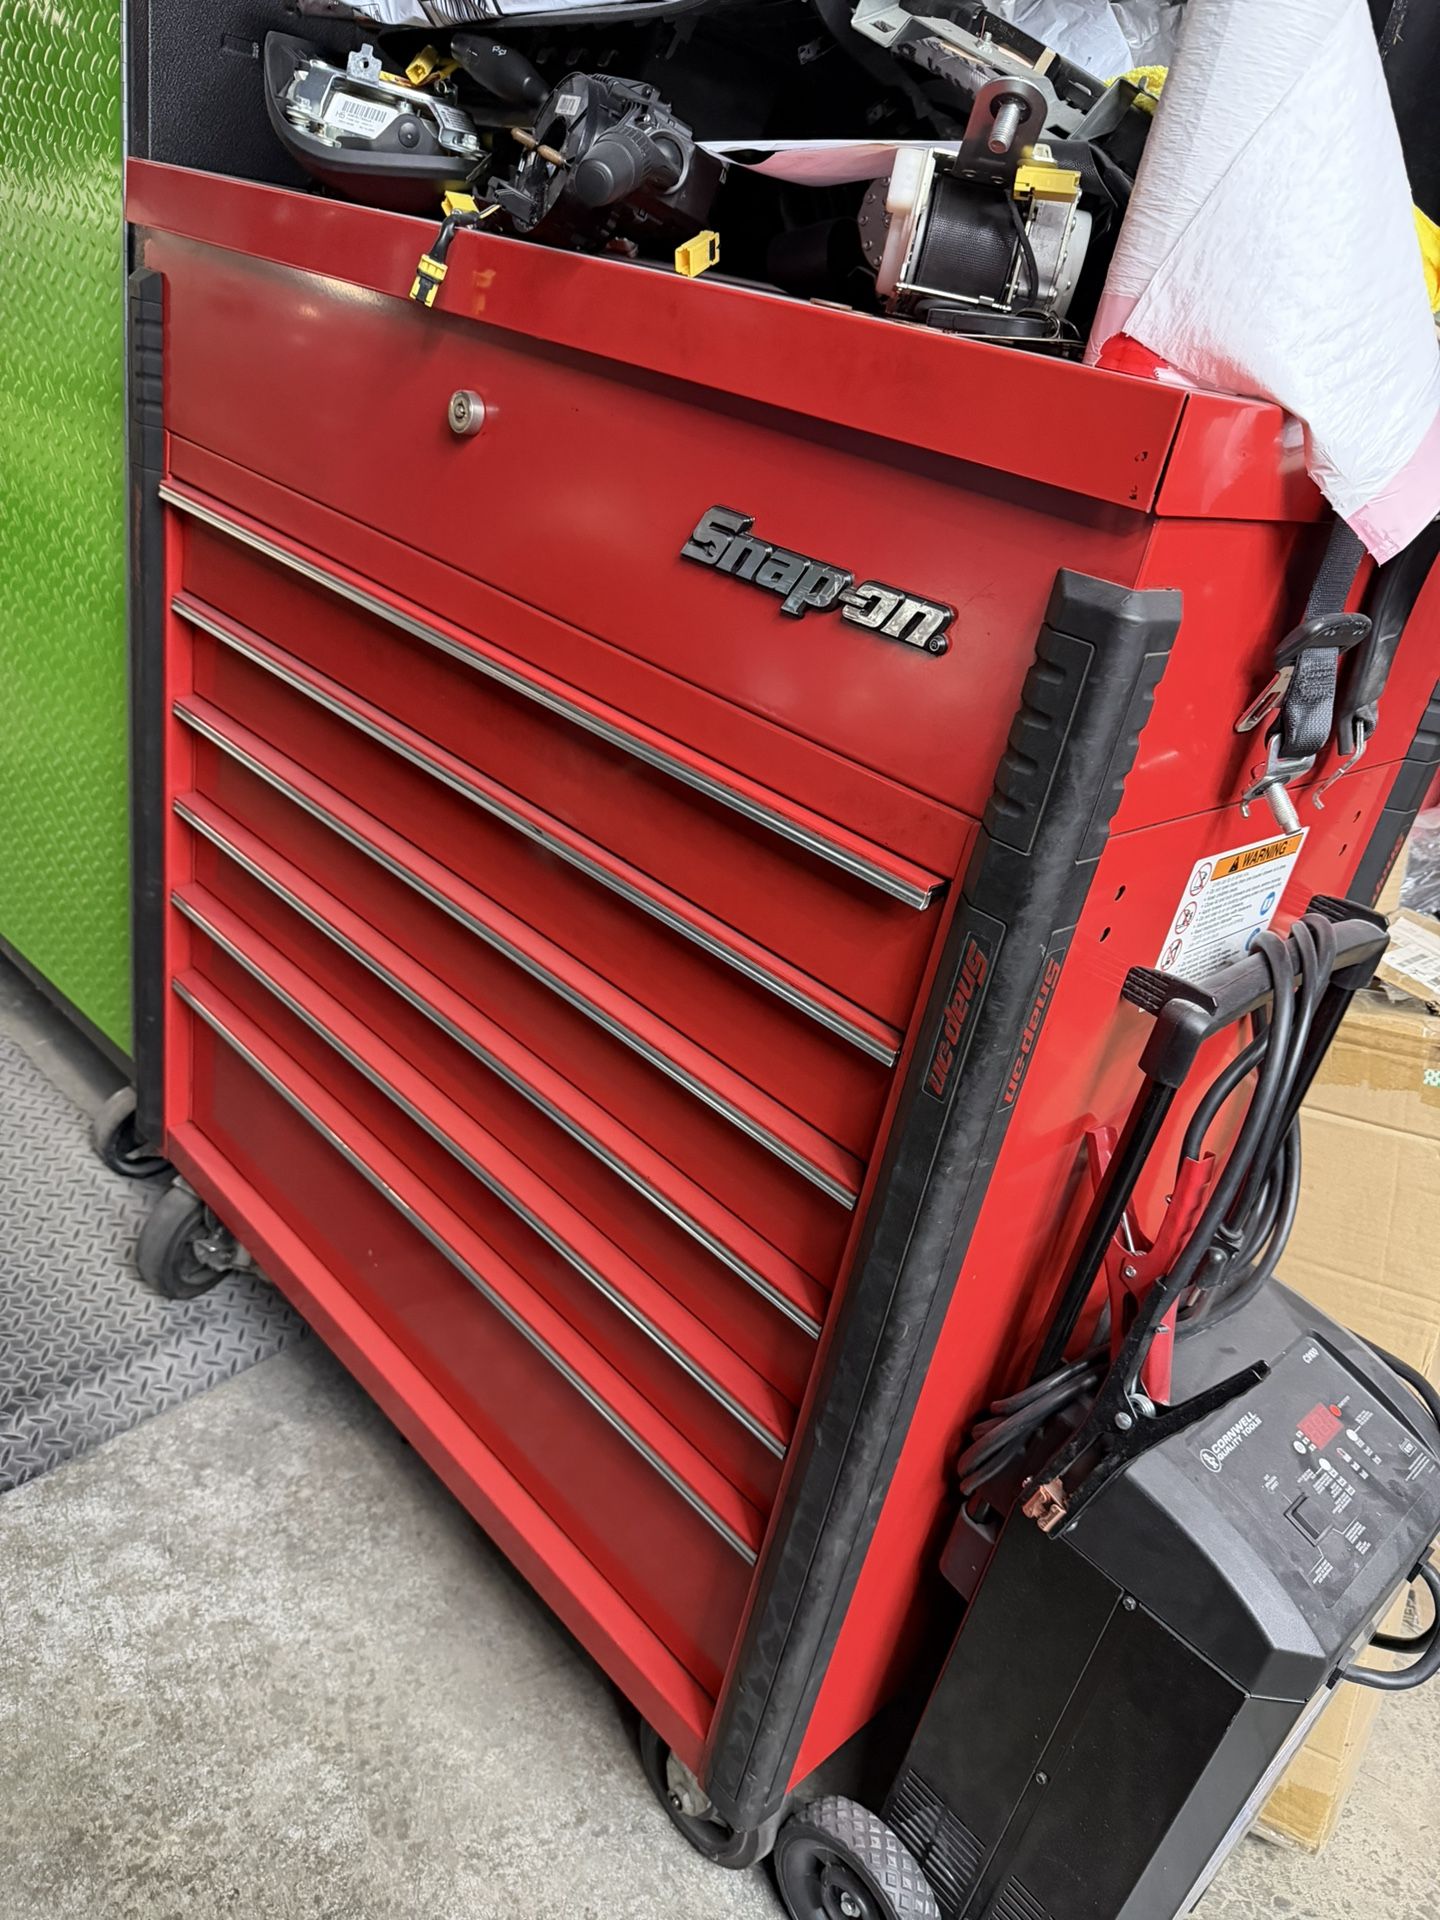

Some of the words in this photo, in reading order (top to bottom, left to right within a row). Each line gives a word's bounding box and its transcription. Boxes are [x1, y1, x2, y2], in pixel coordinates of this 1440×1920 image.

[680, 504, 957, 652] Snap-on
[1241, 841, 1288, 868] WARNING
[1211, 1411, 1257, 1454] CORNWELL
[1217, 1434, 1243, 1461] QUALITY
[1241, 1416, 1262, 1437] TOOLS
